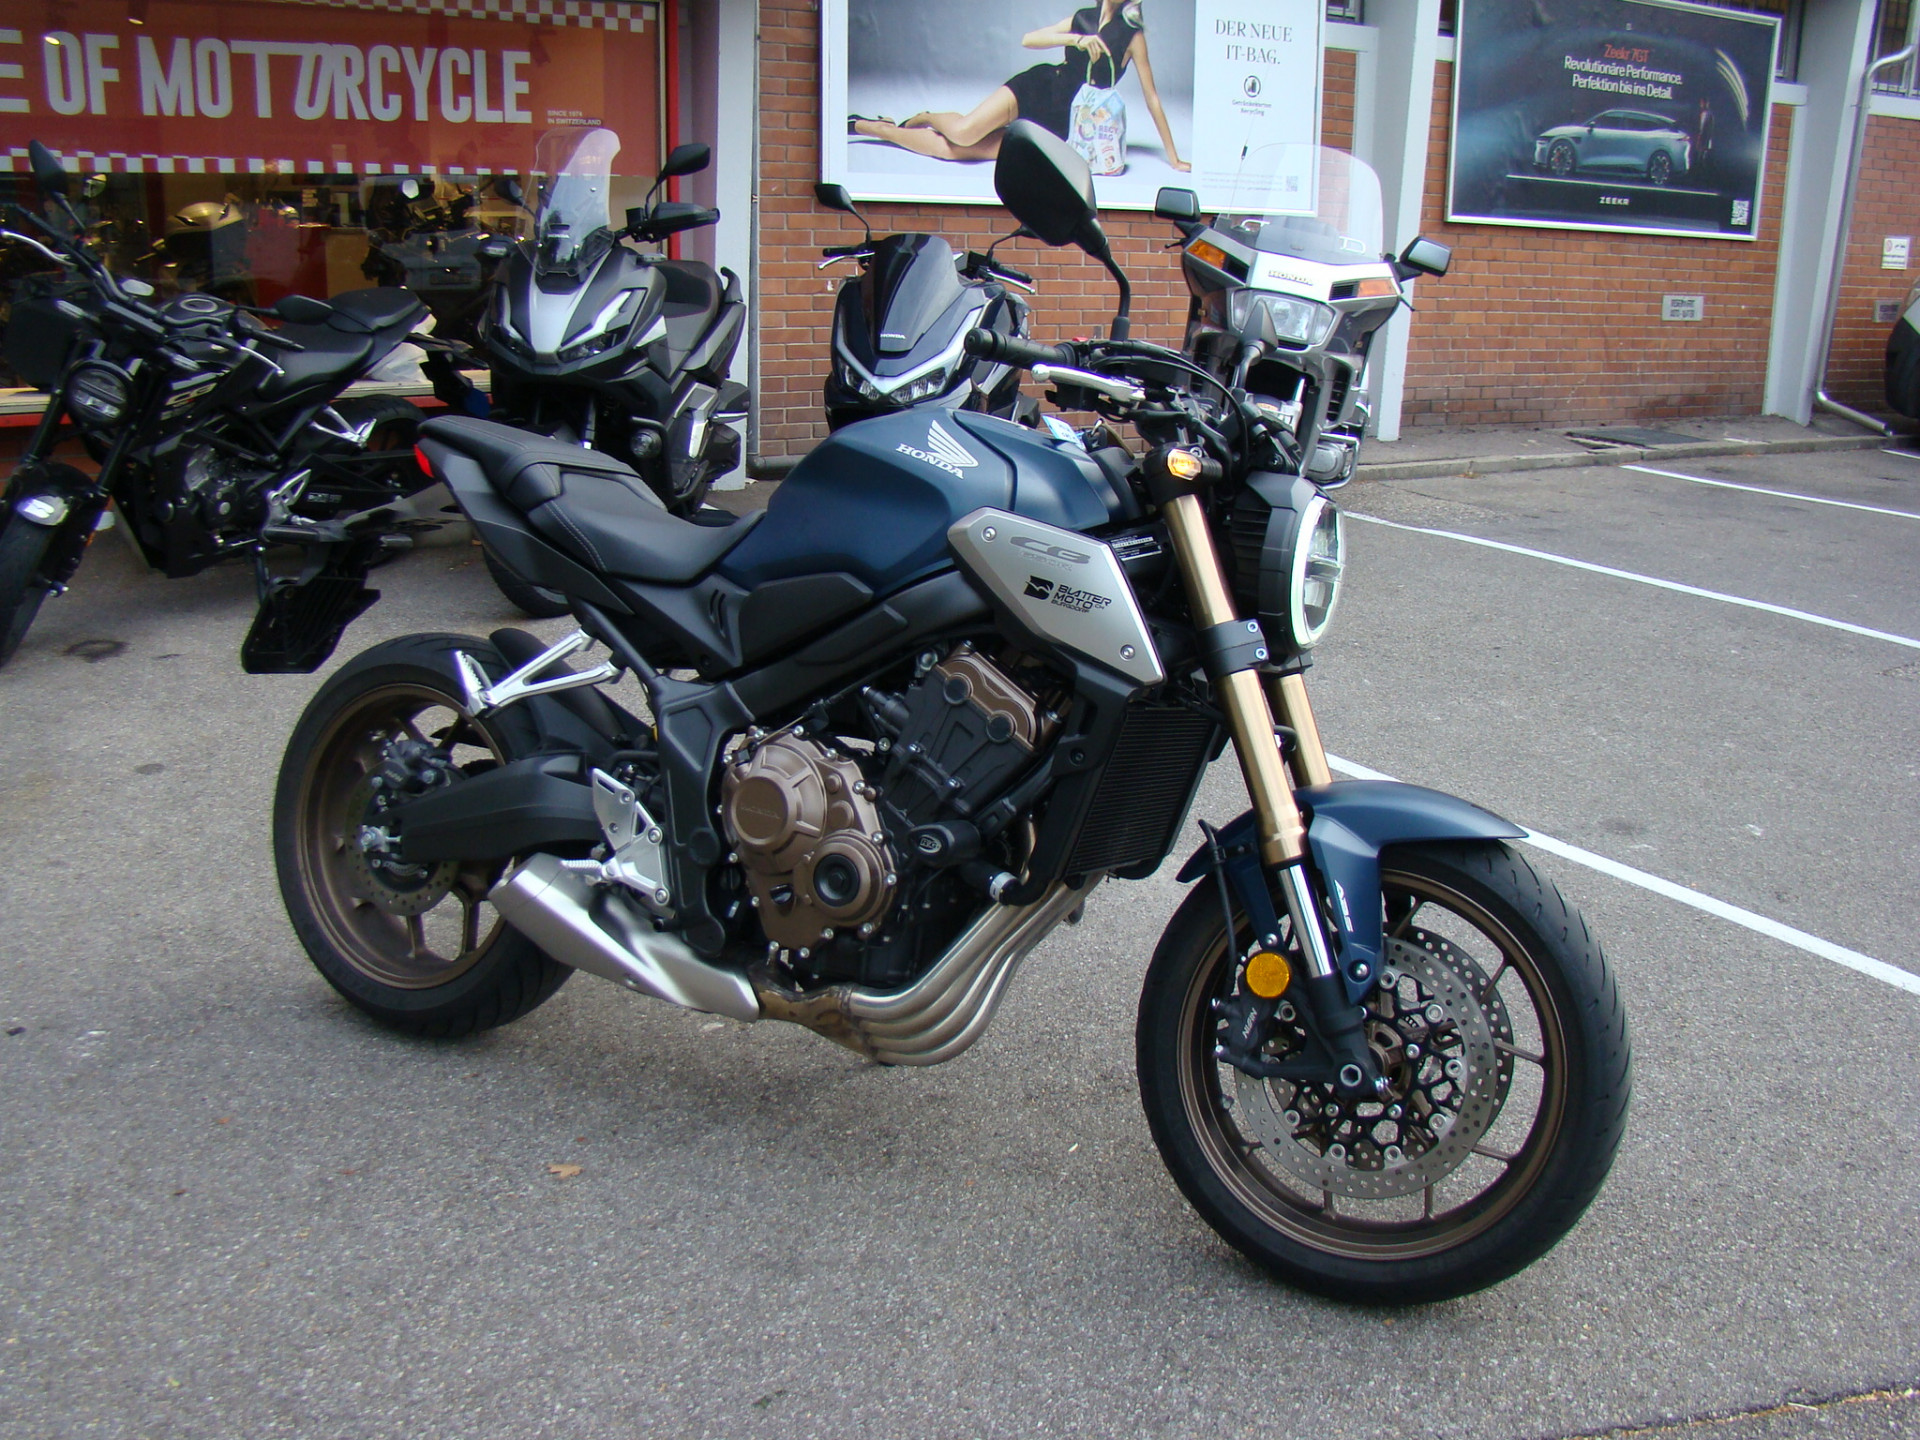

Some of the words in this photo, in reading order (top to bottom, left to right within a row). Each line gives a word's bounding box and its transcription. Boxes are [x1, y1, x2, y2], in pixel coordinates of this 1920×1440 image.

[1215, 19, 1246, 38] DER
[1250, 23, 1293, 43] NEUE
[1226, 44, 1280, 65] IT-BAG.
[1604, 44, 1630, 60] Zeekr
[1631, 47, 1650, 63] 7GT
[43, 31, 120, 116] OF
[137, 36, 532, 123] MOTORCYCLE
[1564, 56, 1625, 77] Revolutionäre
[1626, 64, 1683, 85] Performance.
[1572, 74, 1619, 92] Perfektion
[1619, 80, 1633, 95] bis
[1633, 82, 1647, 96] ins
[1599, 196, 1630, 206] ZEEKR
[895, 443, 964, 480] HONDA
[1010, 536, 1091, 565] CB
[1057, 584, 1113, 607] BLATTER
